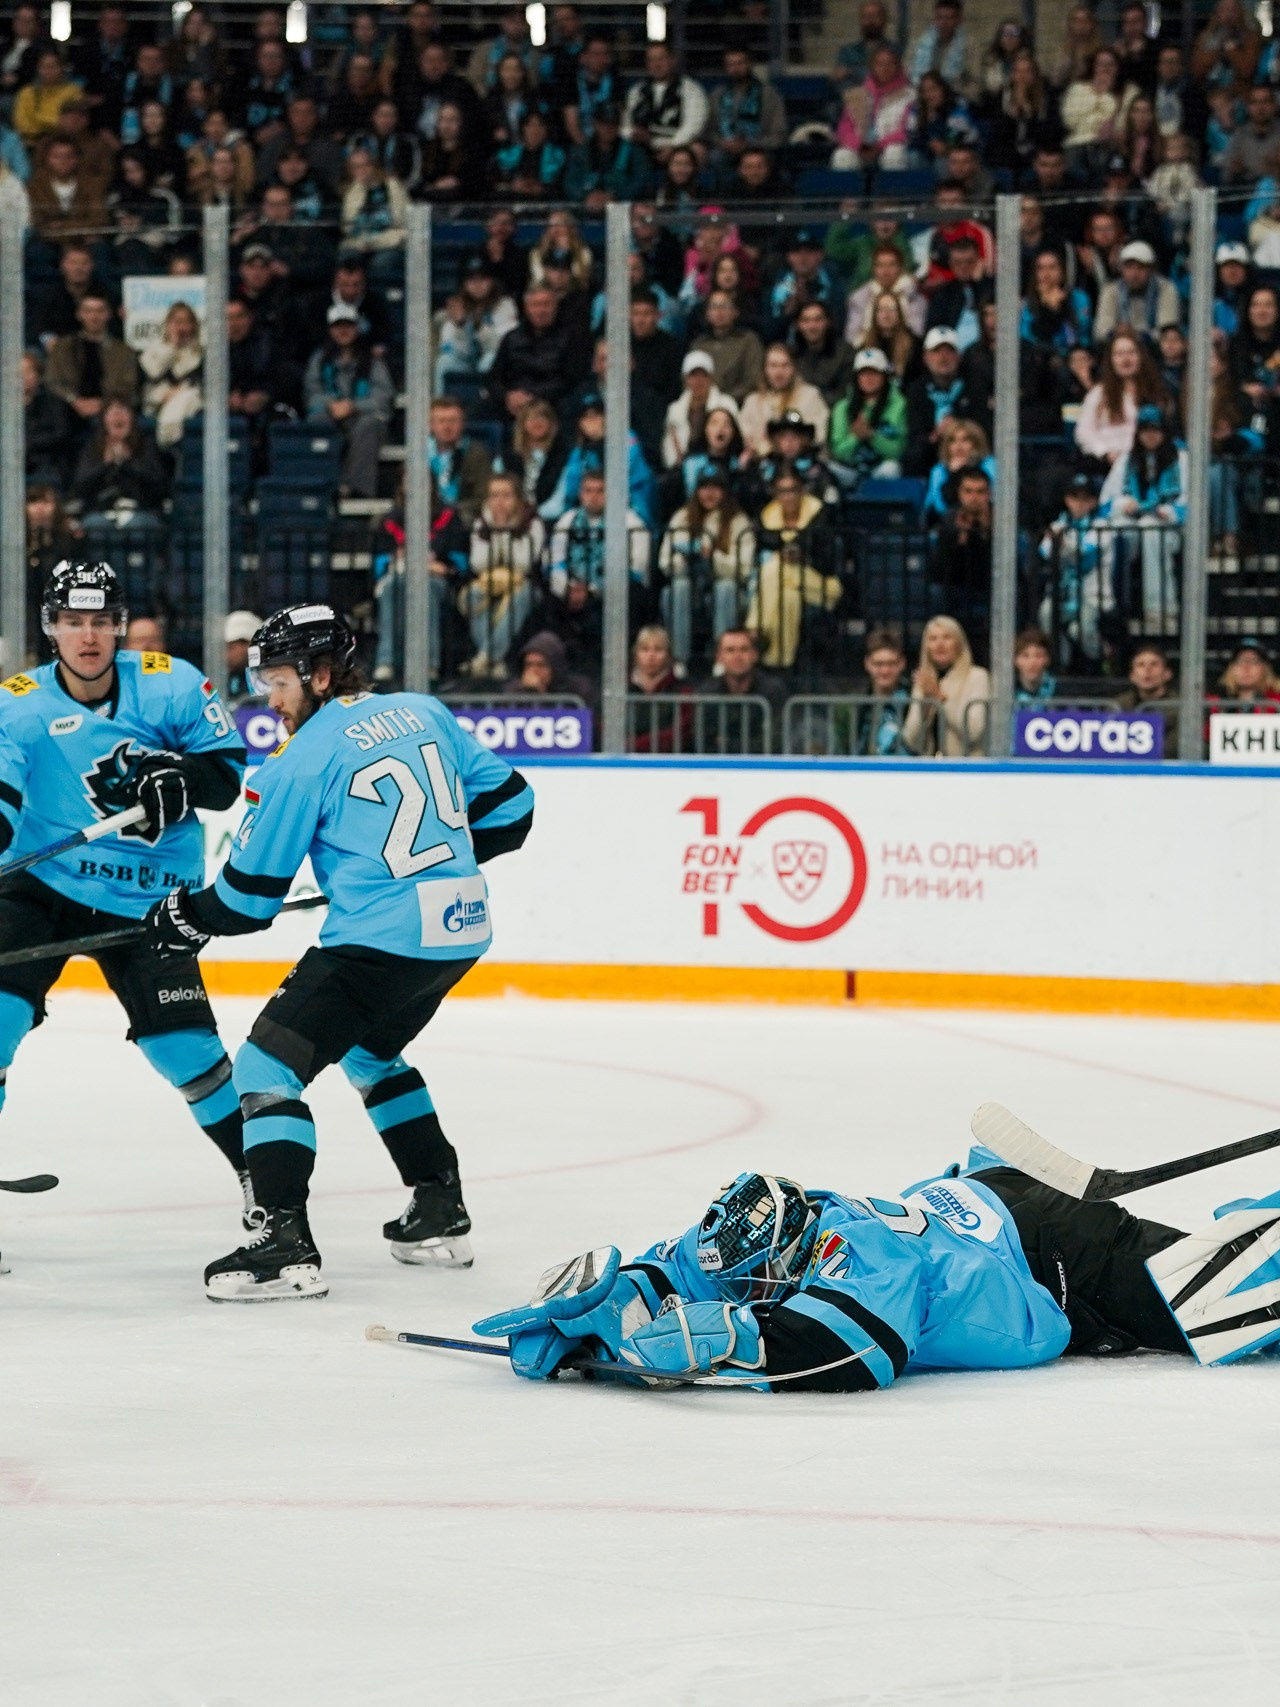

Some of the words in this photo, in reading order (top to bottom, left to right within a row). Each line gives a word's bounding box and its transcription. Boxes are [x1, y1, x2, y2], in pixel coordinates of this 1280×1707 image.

[77, 571, 97, 584] 96
[343, 707, 426, 751] SMITH
[1025, 717, 1155, 755] согаз
[347, 740, 473, 879] 24
[683, 844, 742, 867] FON
[881, 844, 922, 866] НА
[929, 840, 1038, 870] ОДНОЙ
[79, 860, 133, 881] BSB
[682, 871, 739, 893] BET
[881, 876, 984, 900] ЛИНИИ
